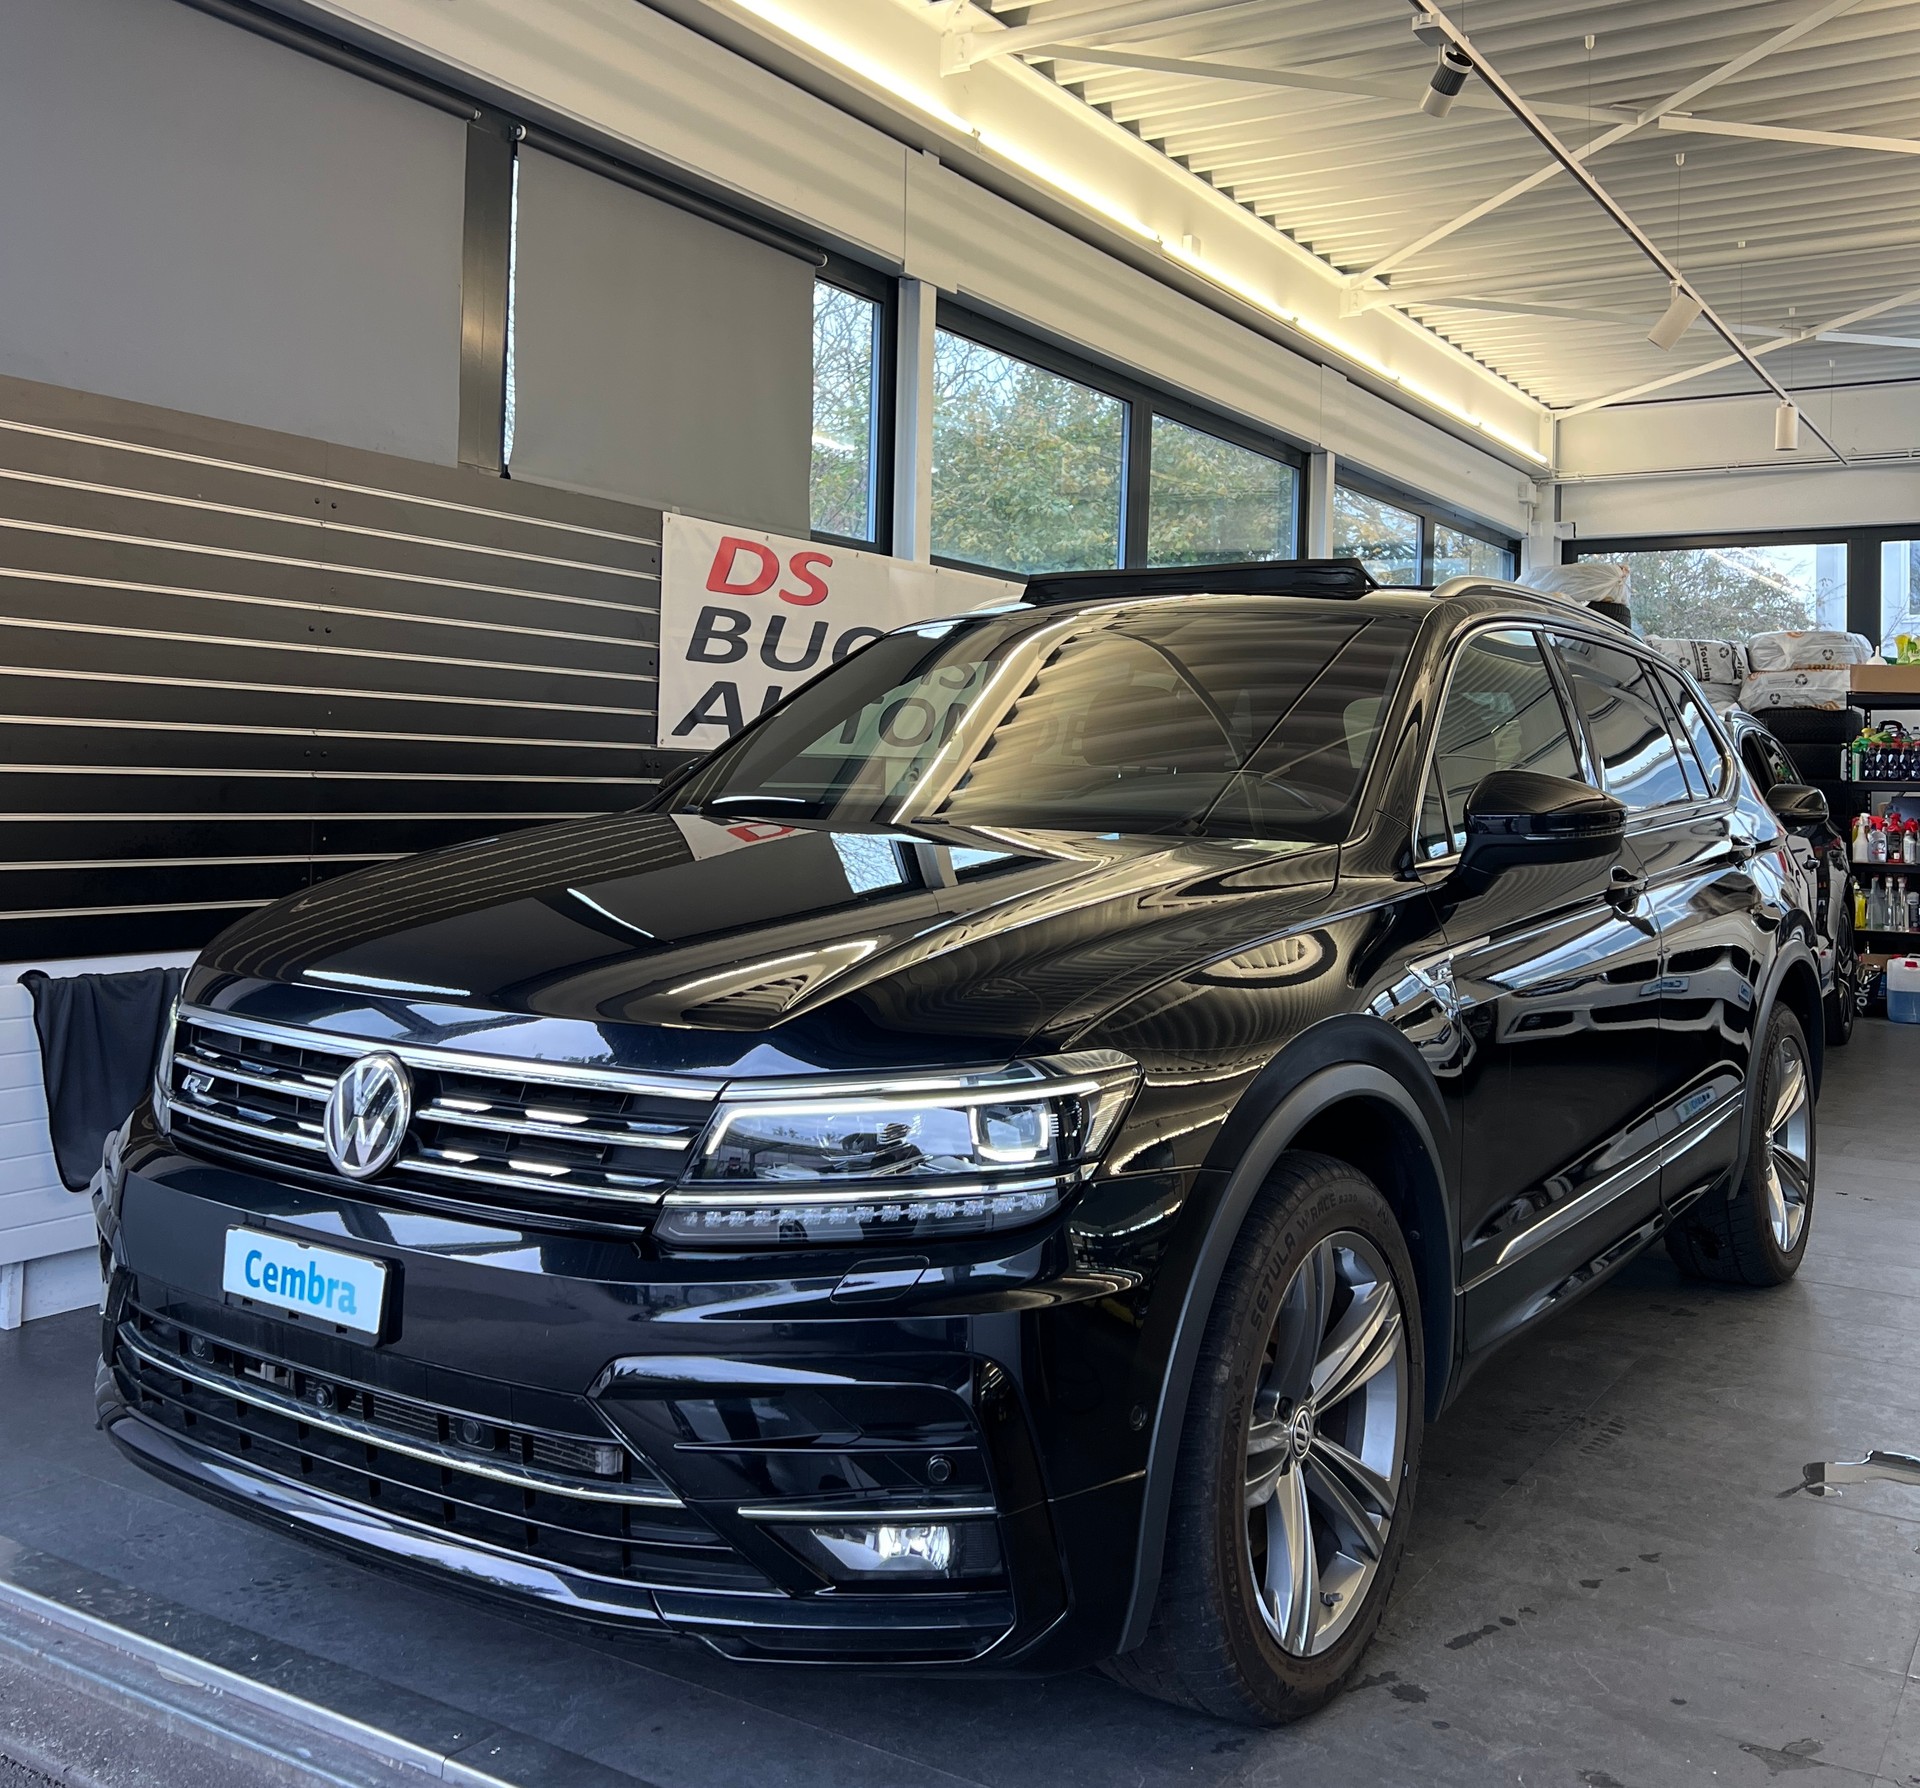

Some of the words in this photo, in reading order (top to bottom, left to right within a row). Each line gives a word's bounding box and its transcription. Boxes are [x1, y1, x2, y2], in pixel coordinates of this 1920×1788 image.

[705, 536, 834, 607] DS
[1699, 645, 1713, 682] Touring
[244, 1250, 358, 1316] Cembra
[1251, 1231, 1297, 1331] SETULA
[1311, 1192, 1337, 1223] RACE
